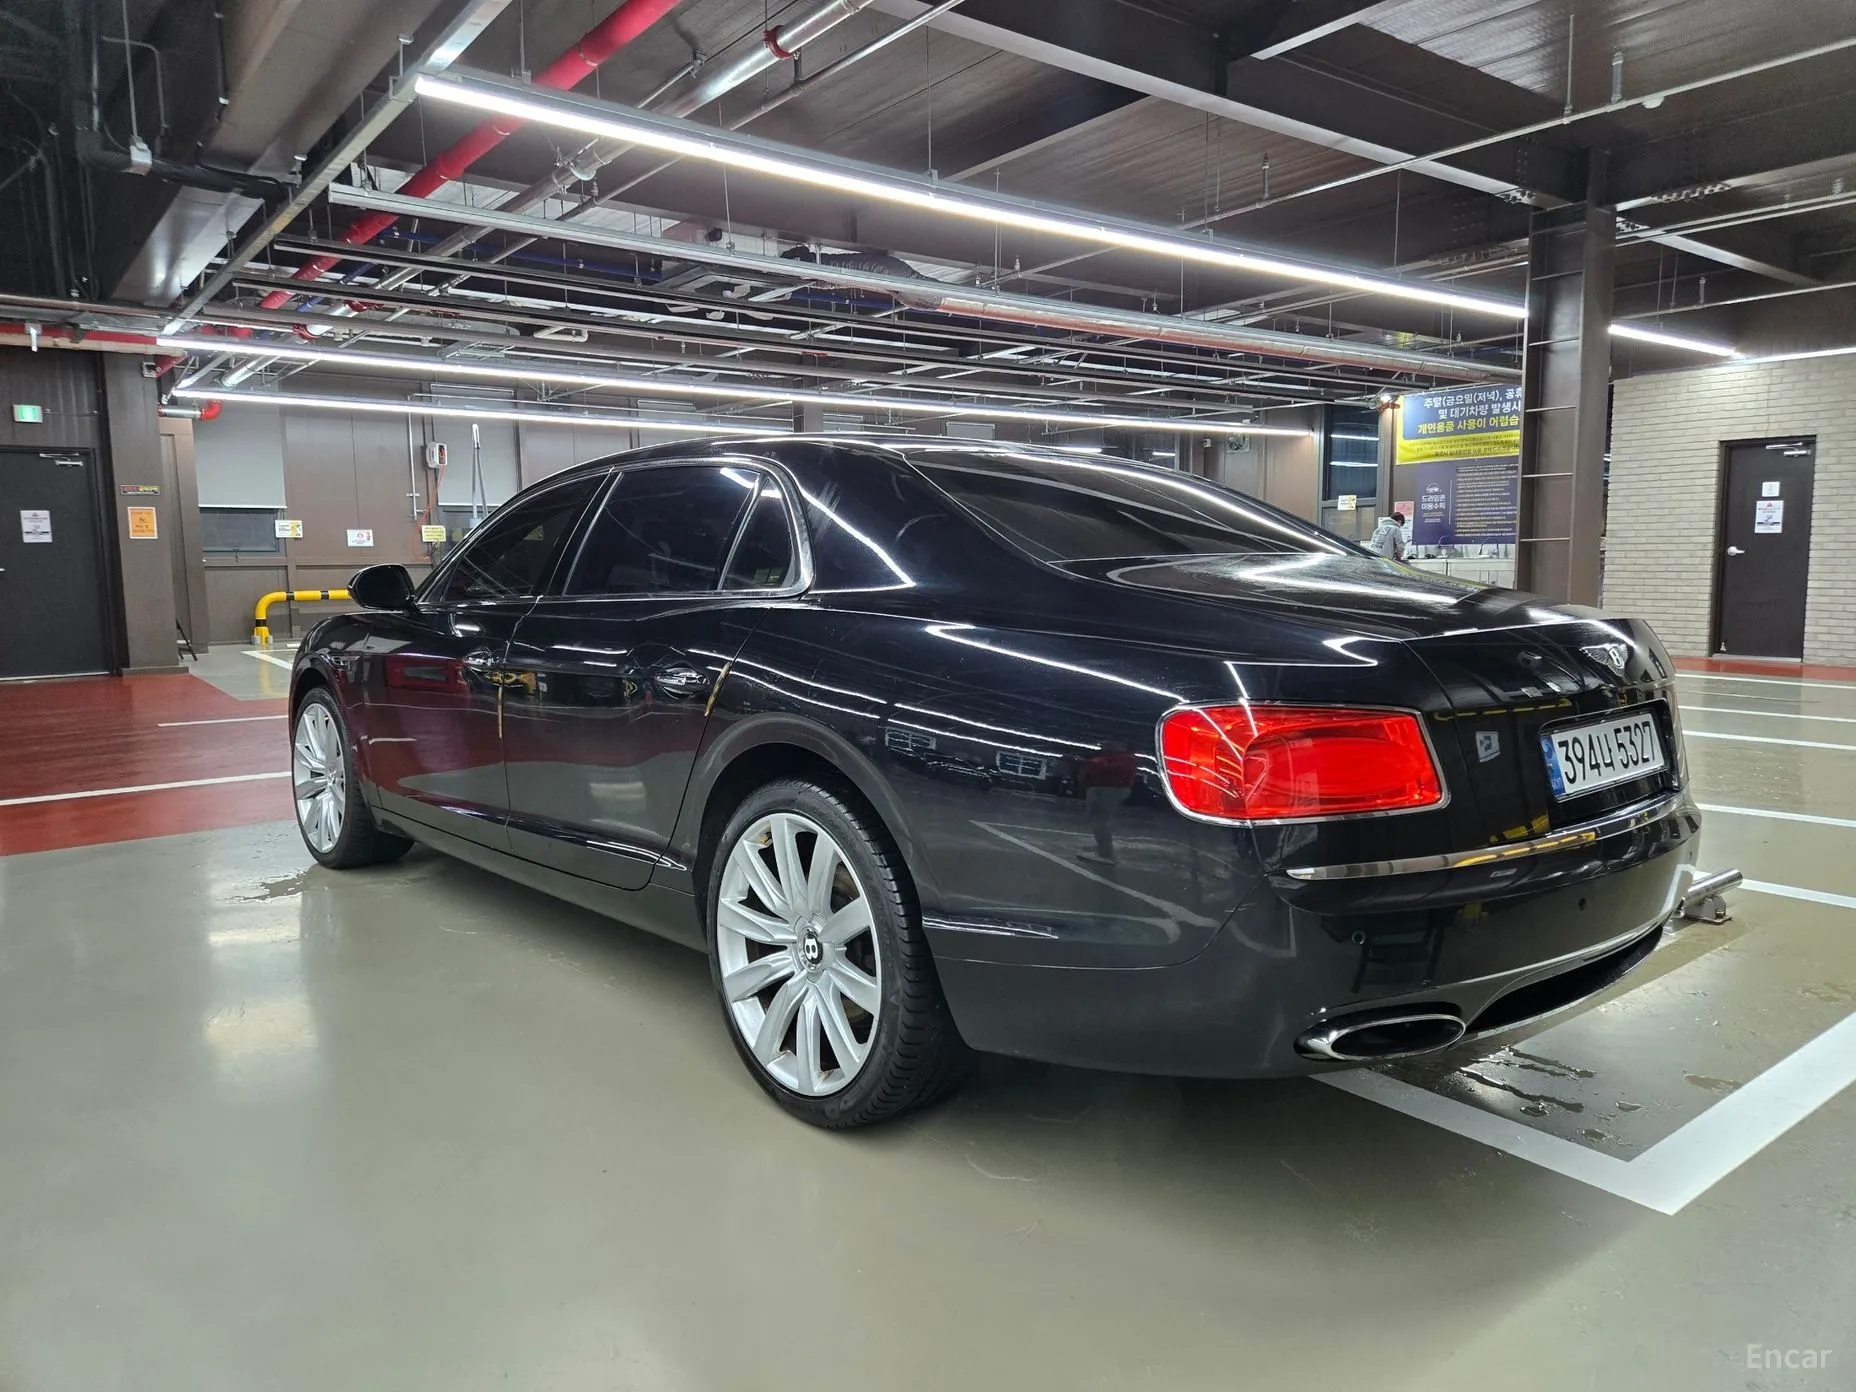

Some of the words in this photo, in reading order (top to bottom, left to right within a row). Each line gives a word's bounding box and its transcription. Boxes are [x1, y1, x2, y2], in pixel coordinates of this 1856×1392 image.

[1438, 409, 1448, 419] 및
[1450, 405, 1489, 418] 대기차량
[1457, 417, 1486, 430] 사용이
[1558, 734, 1615, 784] 394나
[1613, 721, 1655, 769] 5327
